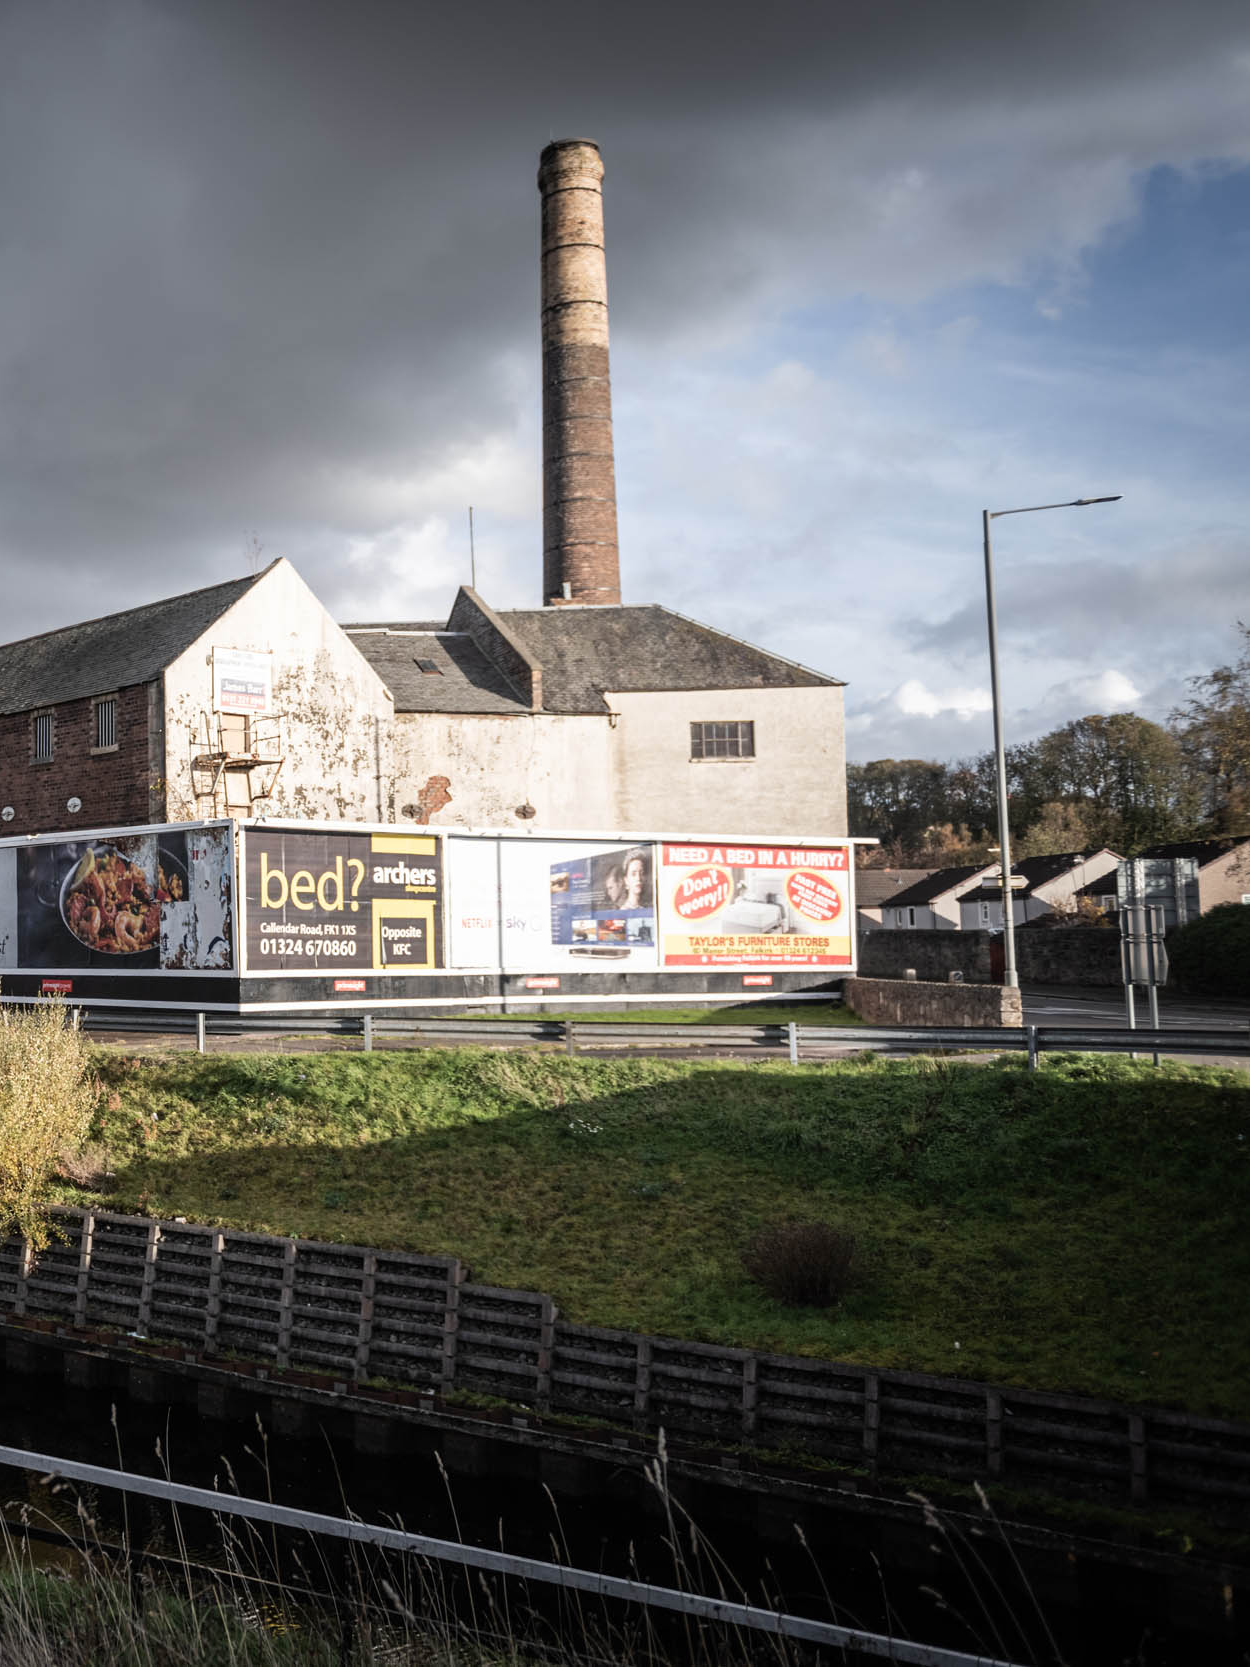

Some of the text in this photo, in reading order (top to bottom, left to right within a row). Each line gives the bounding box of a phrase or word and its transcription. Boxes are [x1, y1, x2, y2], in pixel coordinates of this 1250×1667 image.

[669, 847, 844, 867] NEED A BED IN A HURRY?
[373, 861, 437, 885] archers
[260, 852, 365, 913] bed?
[683, 869, 718, 897] Don't
[678, 882, 729, 916] worry!!
[260, 921, 357, 936] Callendar Road, FK1 1XS
[382, 925, 422, 941] Opposite
[461, 917, 493, 929] NETFLIX
[505, 916, 527, 932] sky
[260, 938, 357, 956] 01324 670860
[392, 943, 412, 955] KFC
[688, 936, 830, 948] TAYLOR'S FURNITURE STORES
